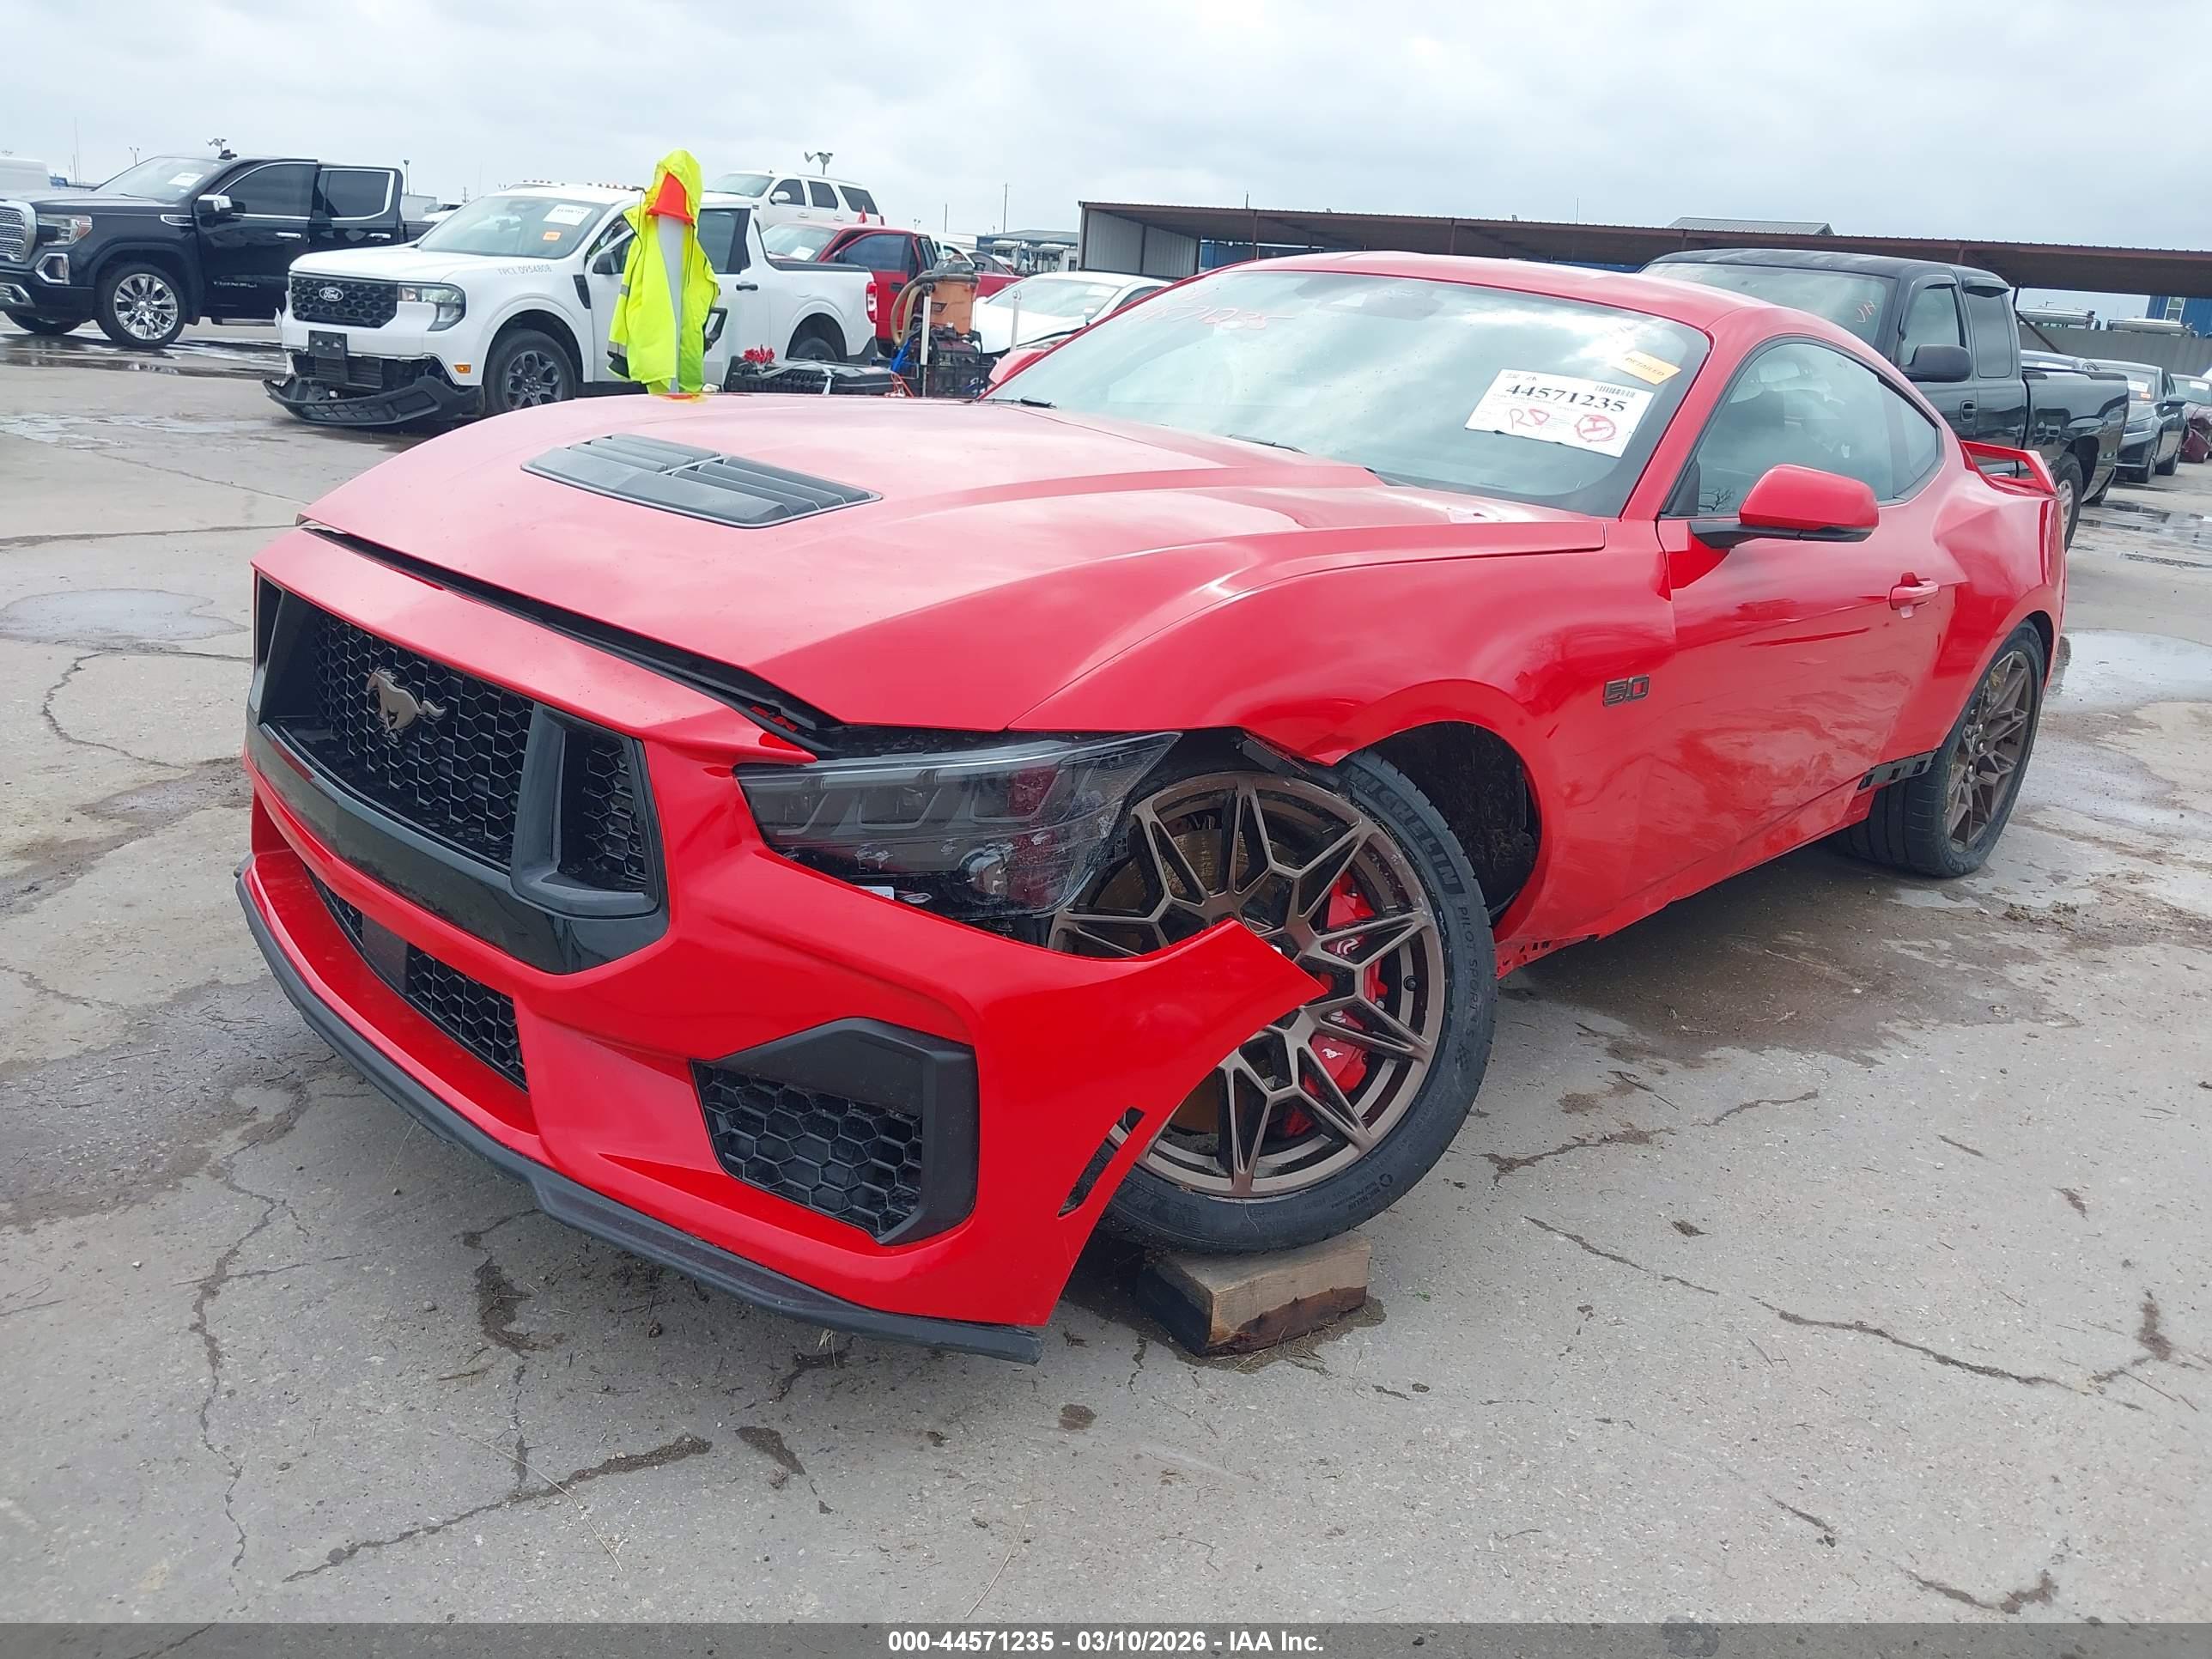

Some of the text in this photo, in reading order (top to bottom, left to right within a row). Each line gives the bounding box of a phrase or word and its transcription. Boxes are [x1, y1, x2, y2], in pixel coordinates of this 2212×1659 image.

[1505, 384, 1629, 413] 44571235
[1346, 766, 1459, 886] MICHELIN
[1457, 905, 1476, 950] PILOT
[1468, 958, 1480, 1011] SPORT
